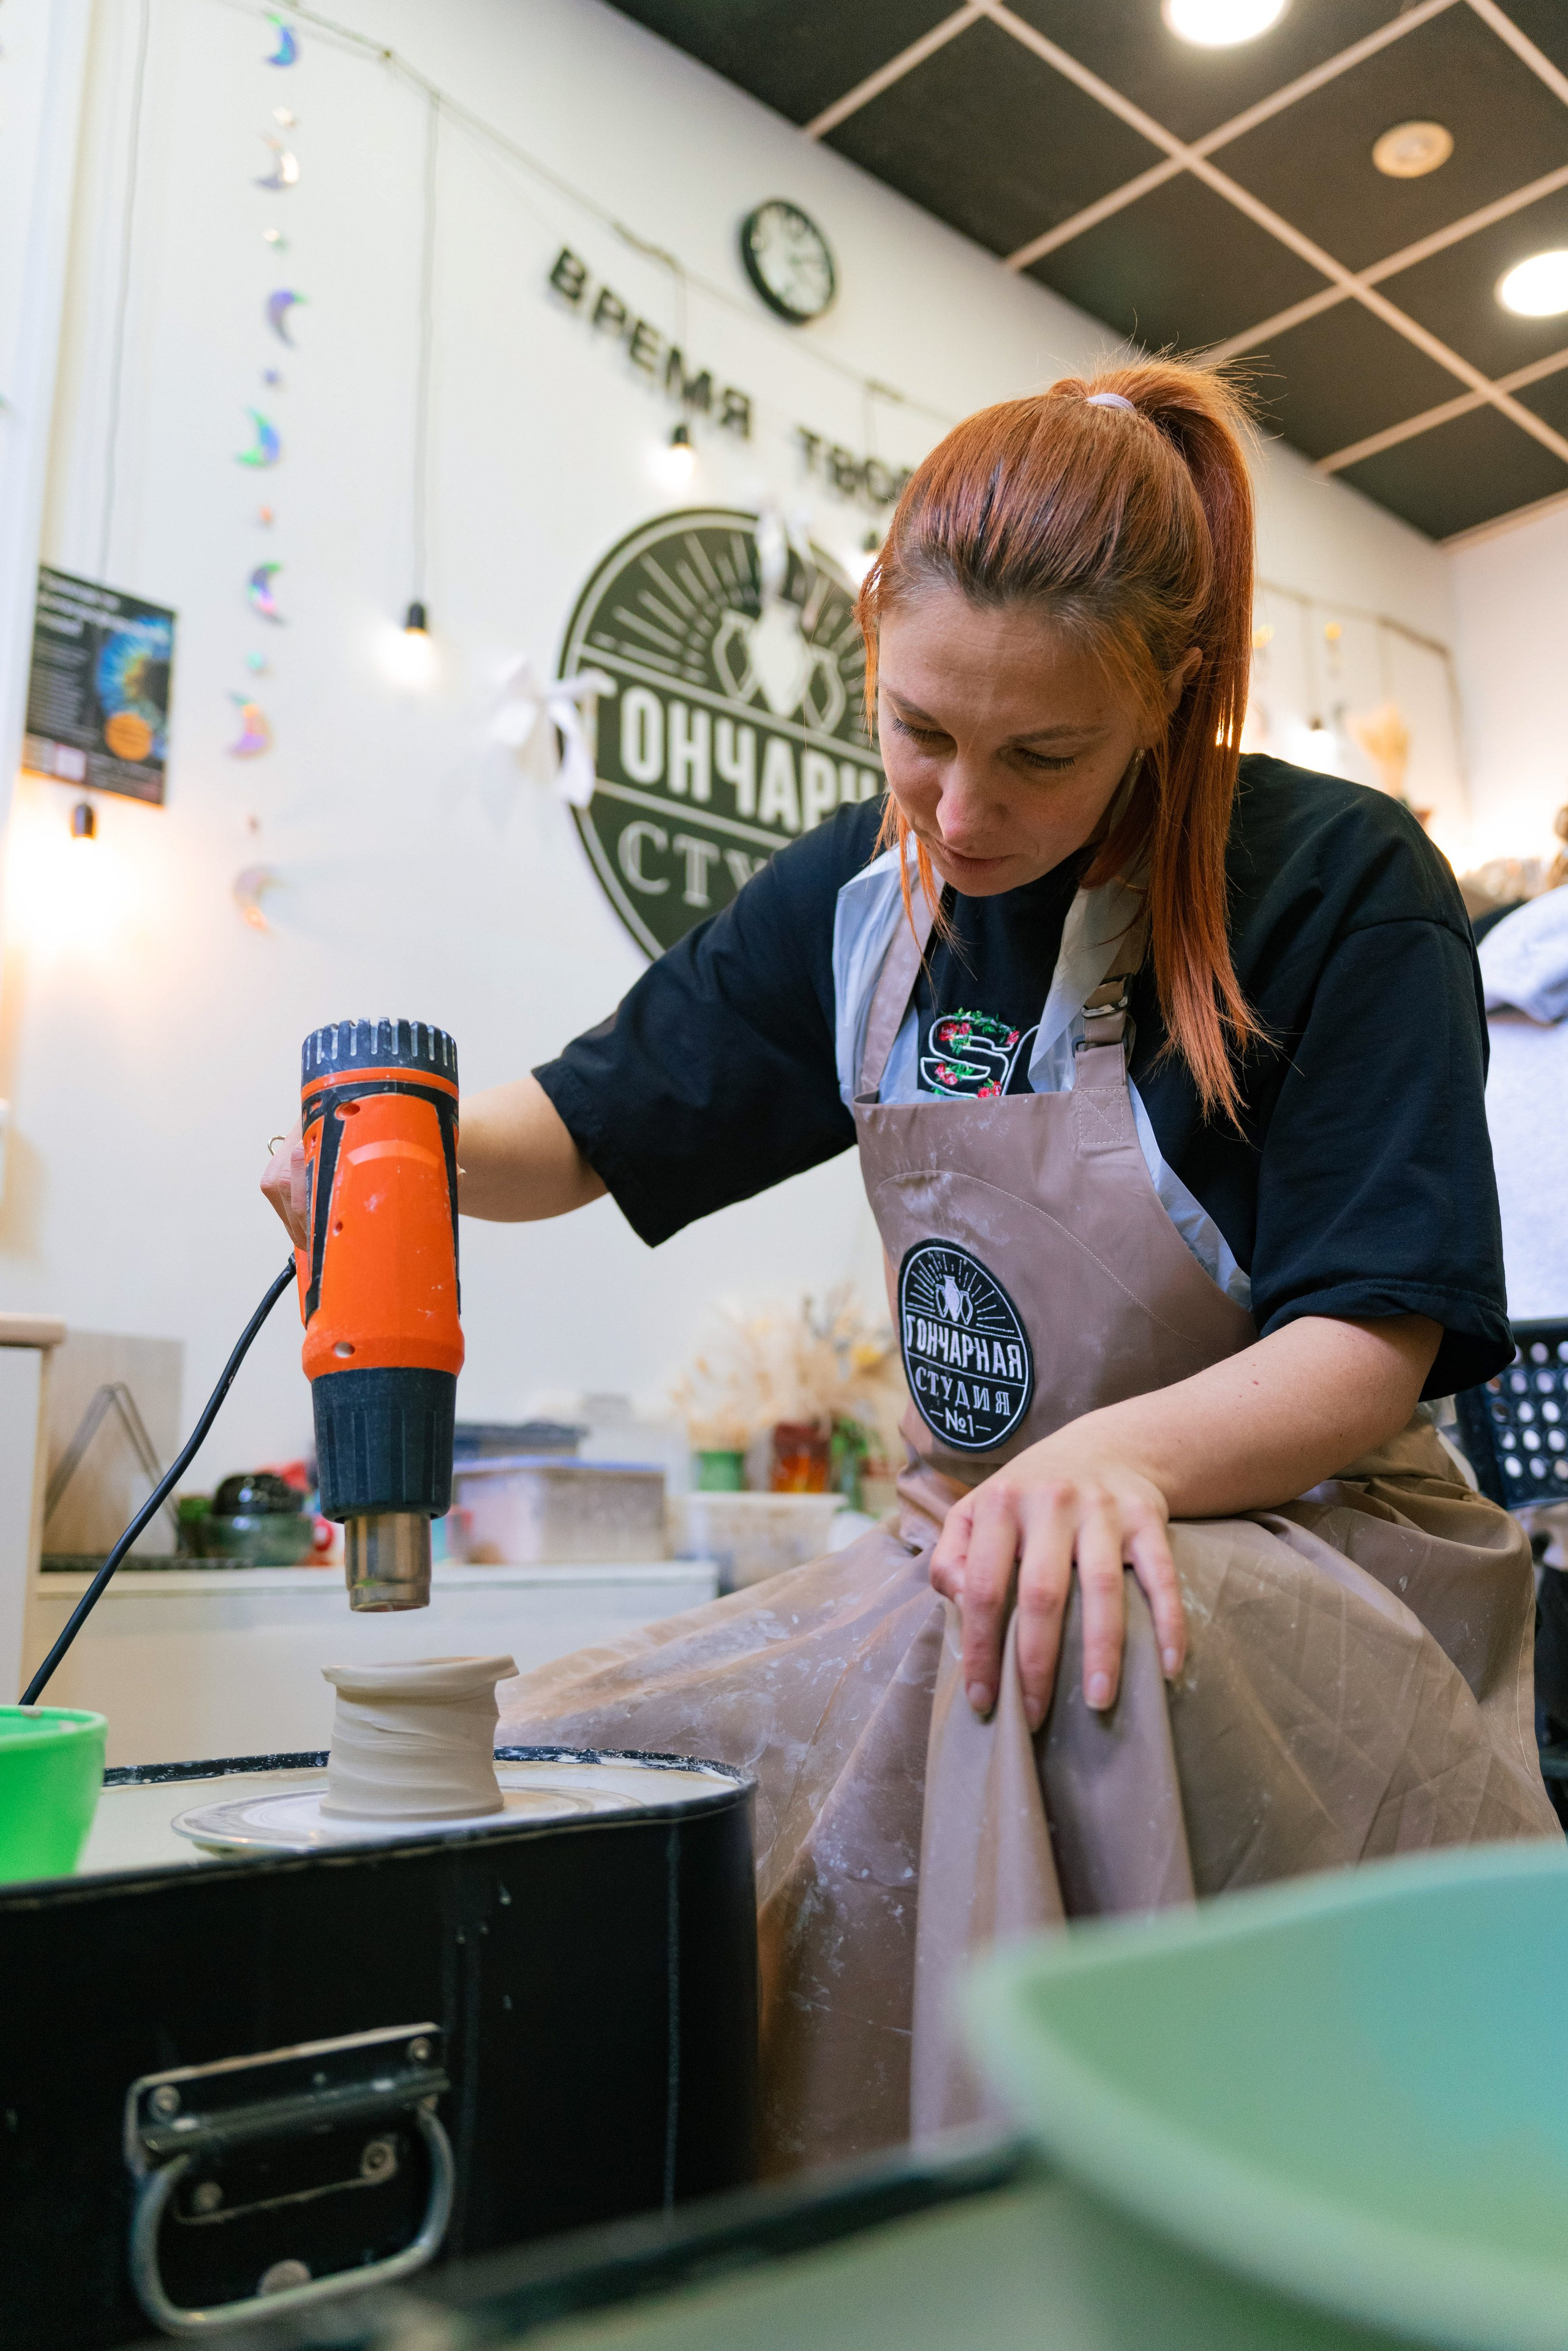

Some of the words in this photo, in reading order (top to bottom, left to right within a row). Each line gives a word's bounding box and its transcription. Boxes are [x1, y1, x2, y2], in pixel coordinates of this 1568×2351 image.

[550, 246, 752, 440] ВРЕМЯ
[907, 1315, 1023, 1379] ГОНЧАРНАЯ
[915, 1367, 1011, 1416] СТУДИЯ
